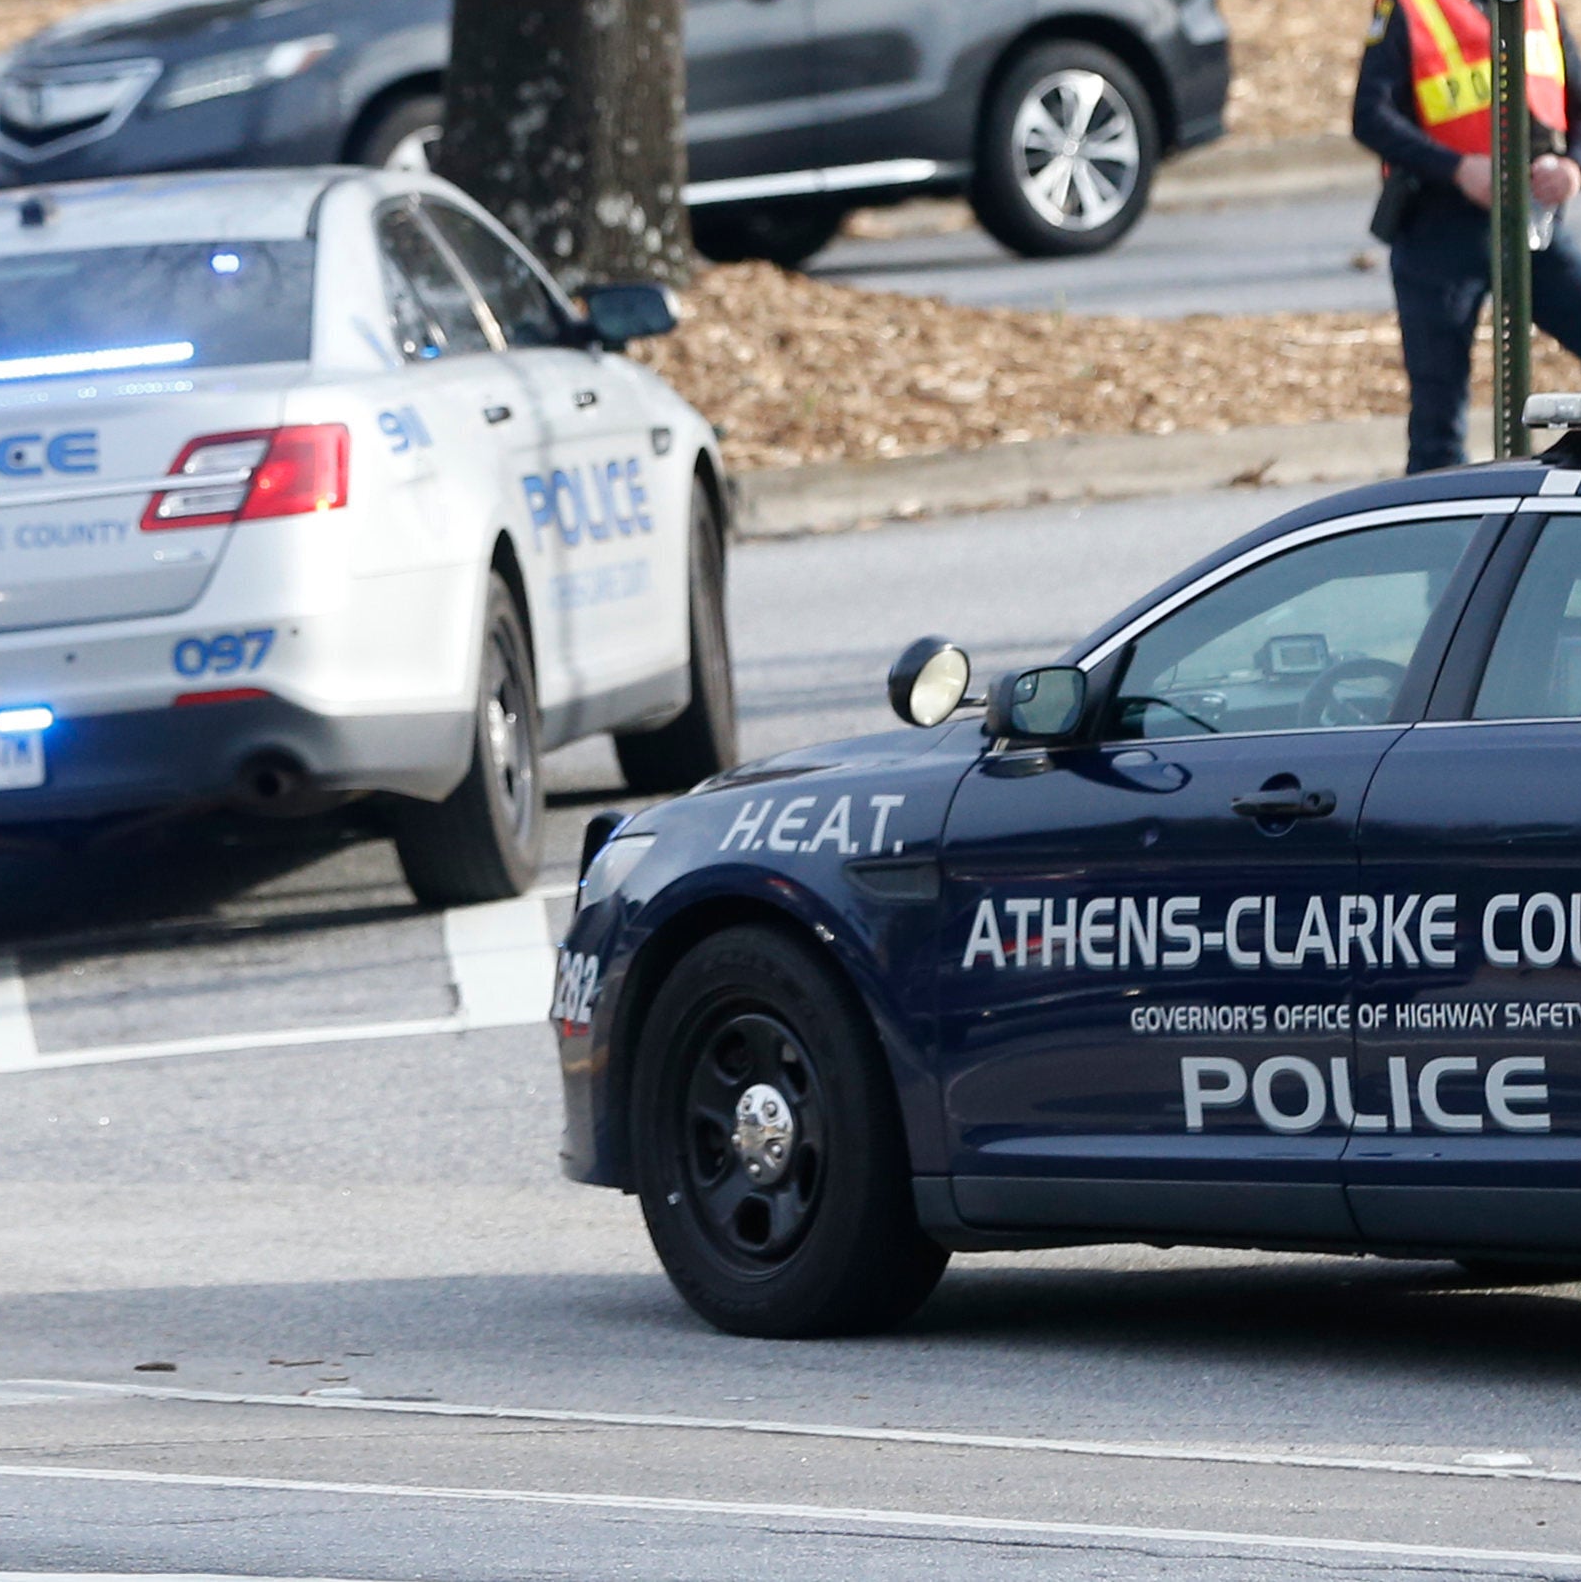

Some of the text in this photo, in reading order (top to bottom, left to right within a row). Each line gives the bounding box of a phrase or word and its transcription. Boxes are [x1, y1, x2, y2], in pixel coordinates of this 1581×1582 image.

[14, 519, 132, 550] COUNTY
[521, 457, 654, 554] POLICE
[173, 627, 275, 678] 097
[718, 793, 907, 856] H.E.A.T.
[961, 893, 1458, 971] ATHENS-CLARKE
[1130, 1004, 1267, 1034] GOVERNOR'S
[1274, 1004, 1350, 1032] OFFICE
[1358, 1002, 1389, 1030] OF
[1395, 1002, 1499, 1030] HIGHWAY
[1180, 1053, 1552, 1135] POLICE
